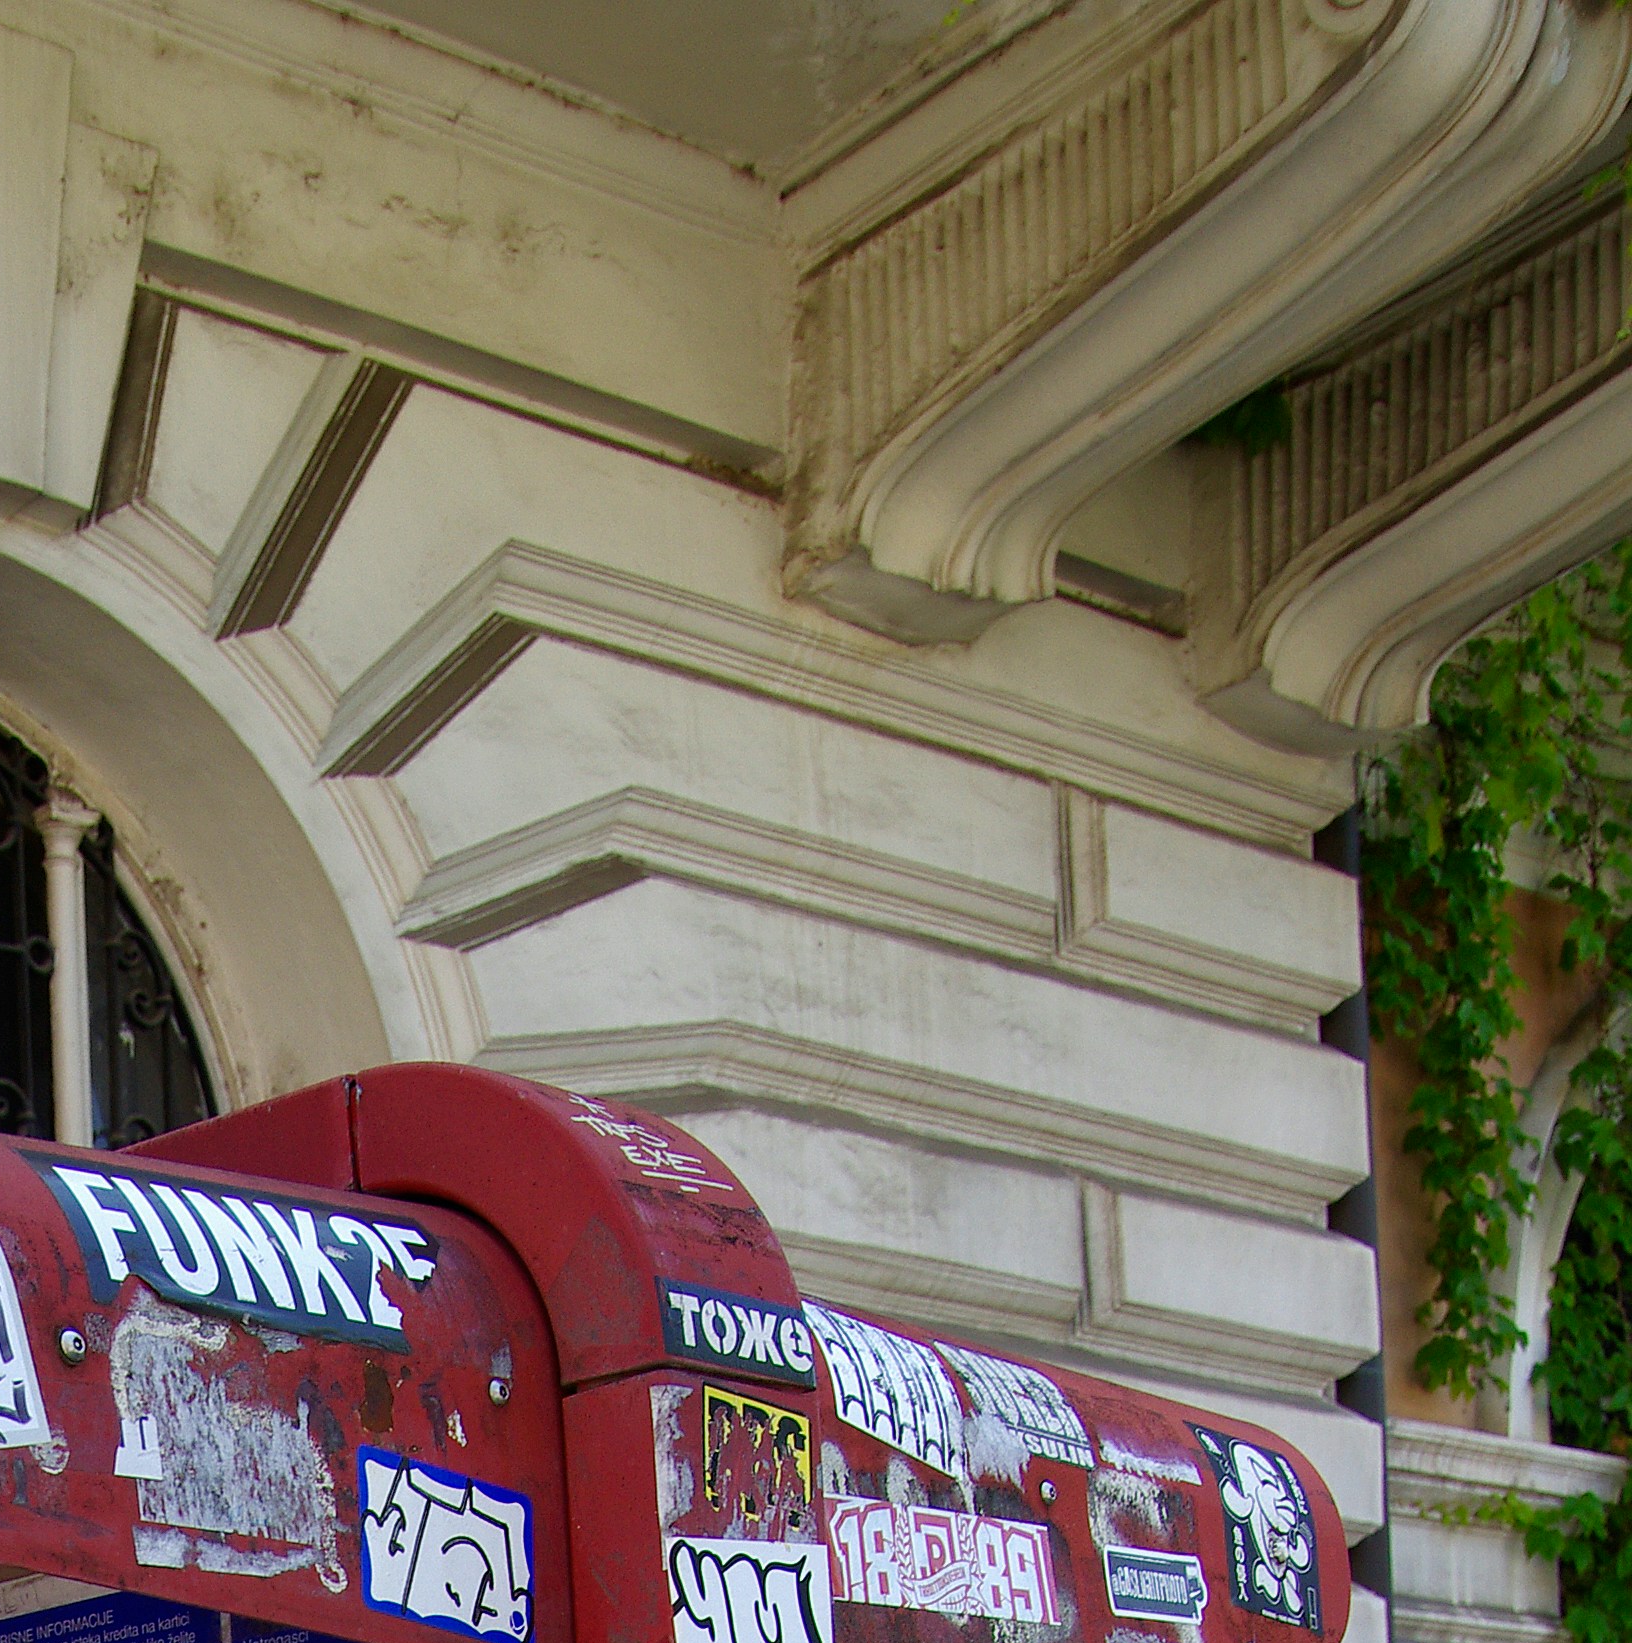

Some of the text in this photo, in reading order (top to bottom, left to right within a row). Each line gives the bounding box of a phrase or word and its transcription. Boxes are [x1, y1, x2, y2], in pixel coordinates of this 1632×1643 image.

[37, 1610, 114, 1639] INFORMACIJE
[104, 1624, 139, 1641] kredita
[158, 1612, 190, 1629] kartici
